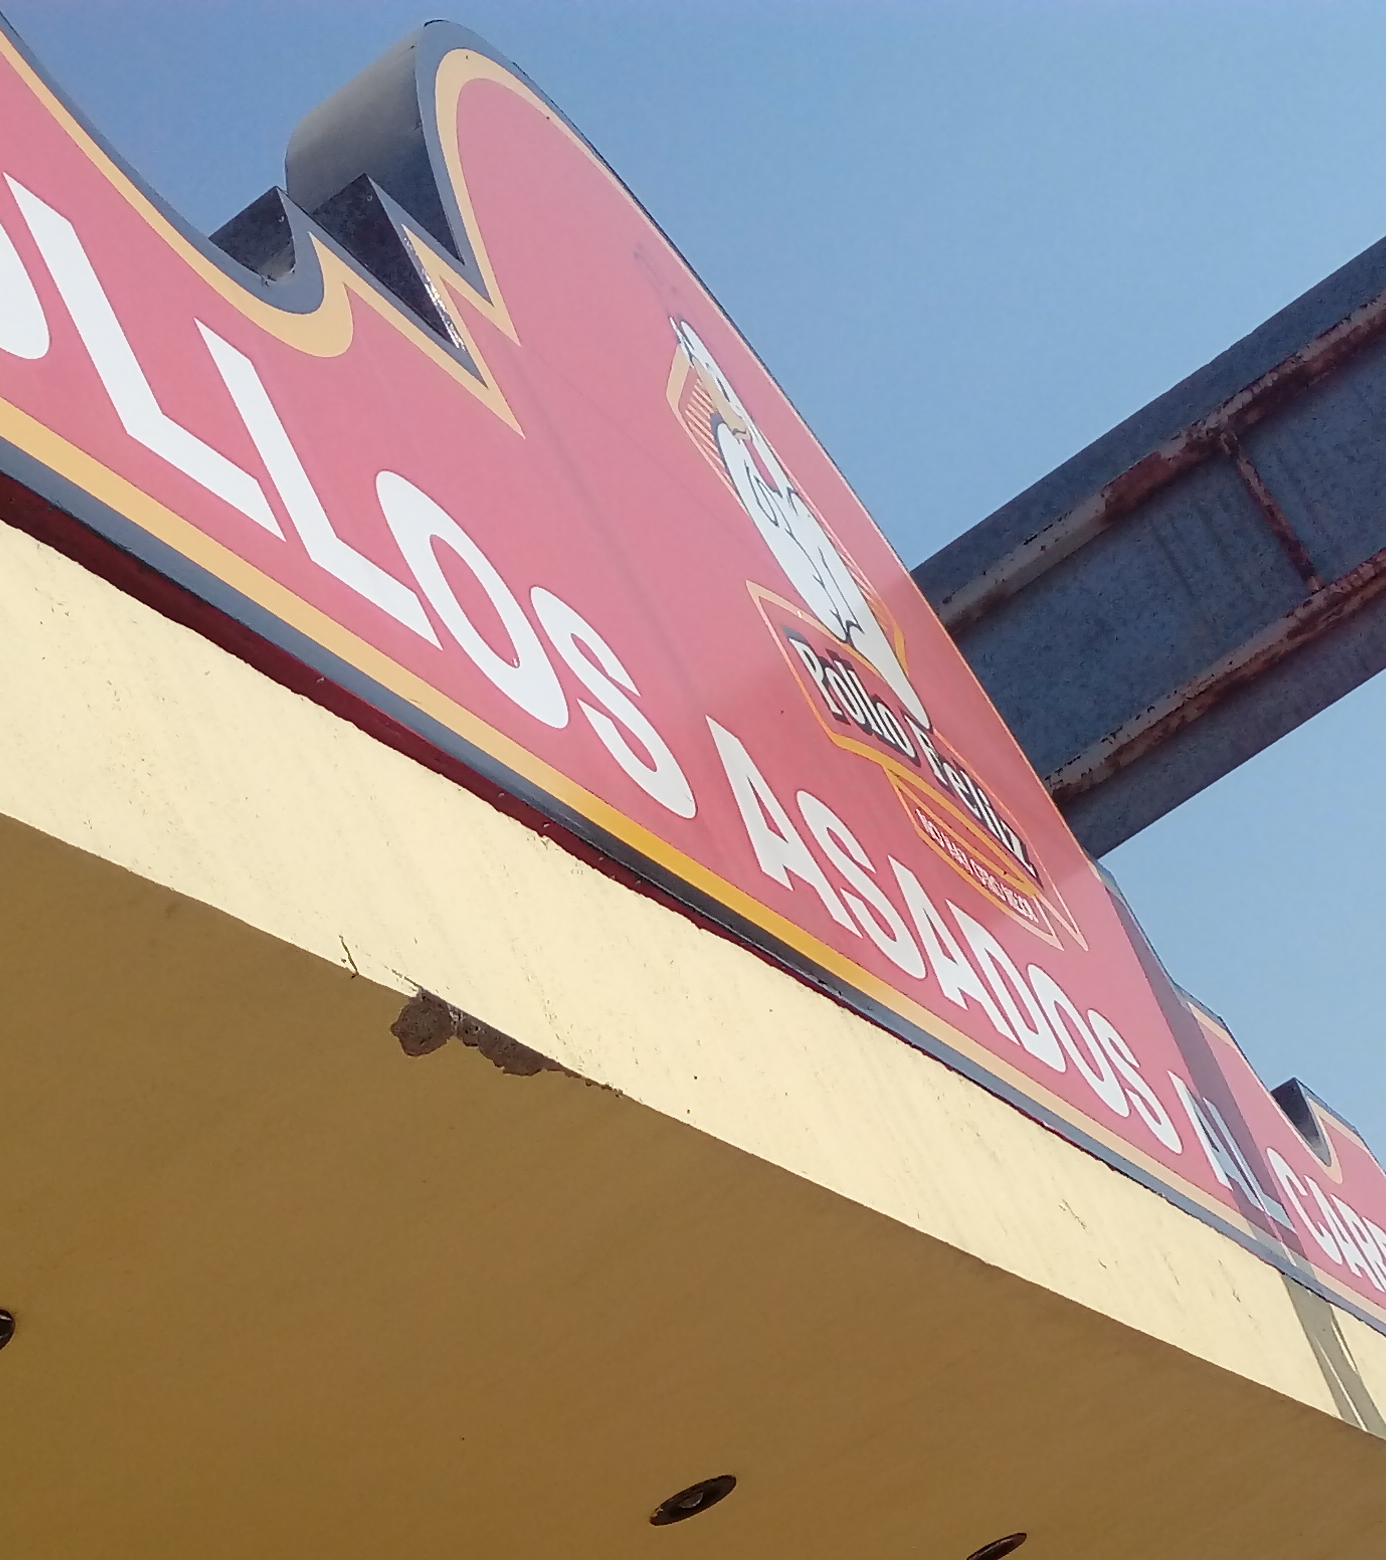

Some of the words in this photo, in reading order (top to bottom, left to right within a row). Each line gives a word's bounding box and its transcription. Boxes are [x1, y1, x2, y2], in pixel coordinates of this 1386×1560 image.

[788, 636, 917, 760] Pollo
[904, 714, 1039, 879] Feliz
[707, 716, 1182, 1155] ASADOS
[1168, 1069, 1298, 1234] AL
